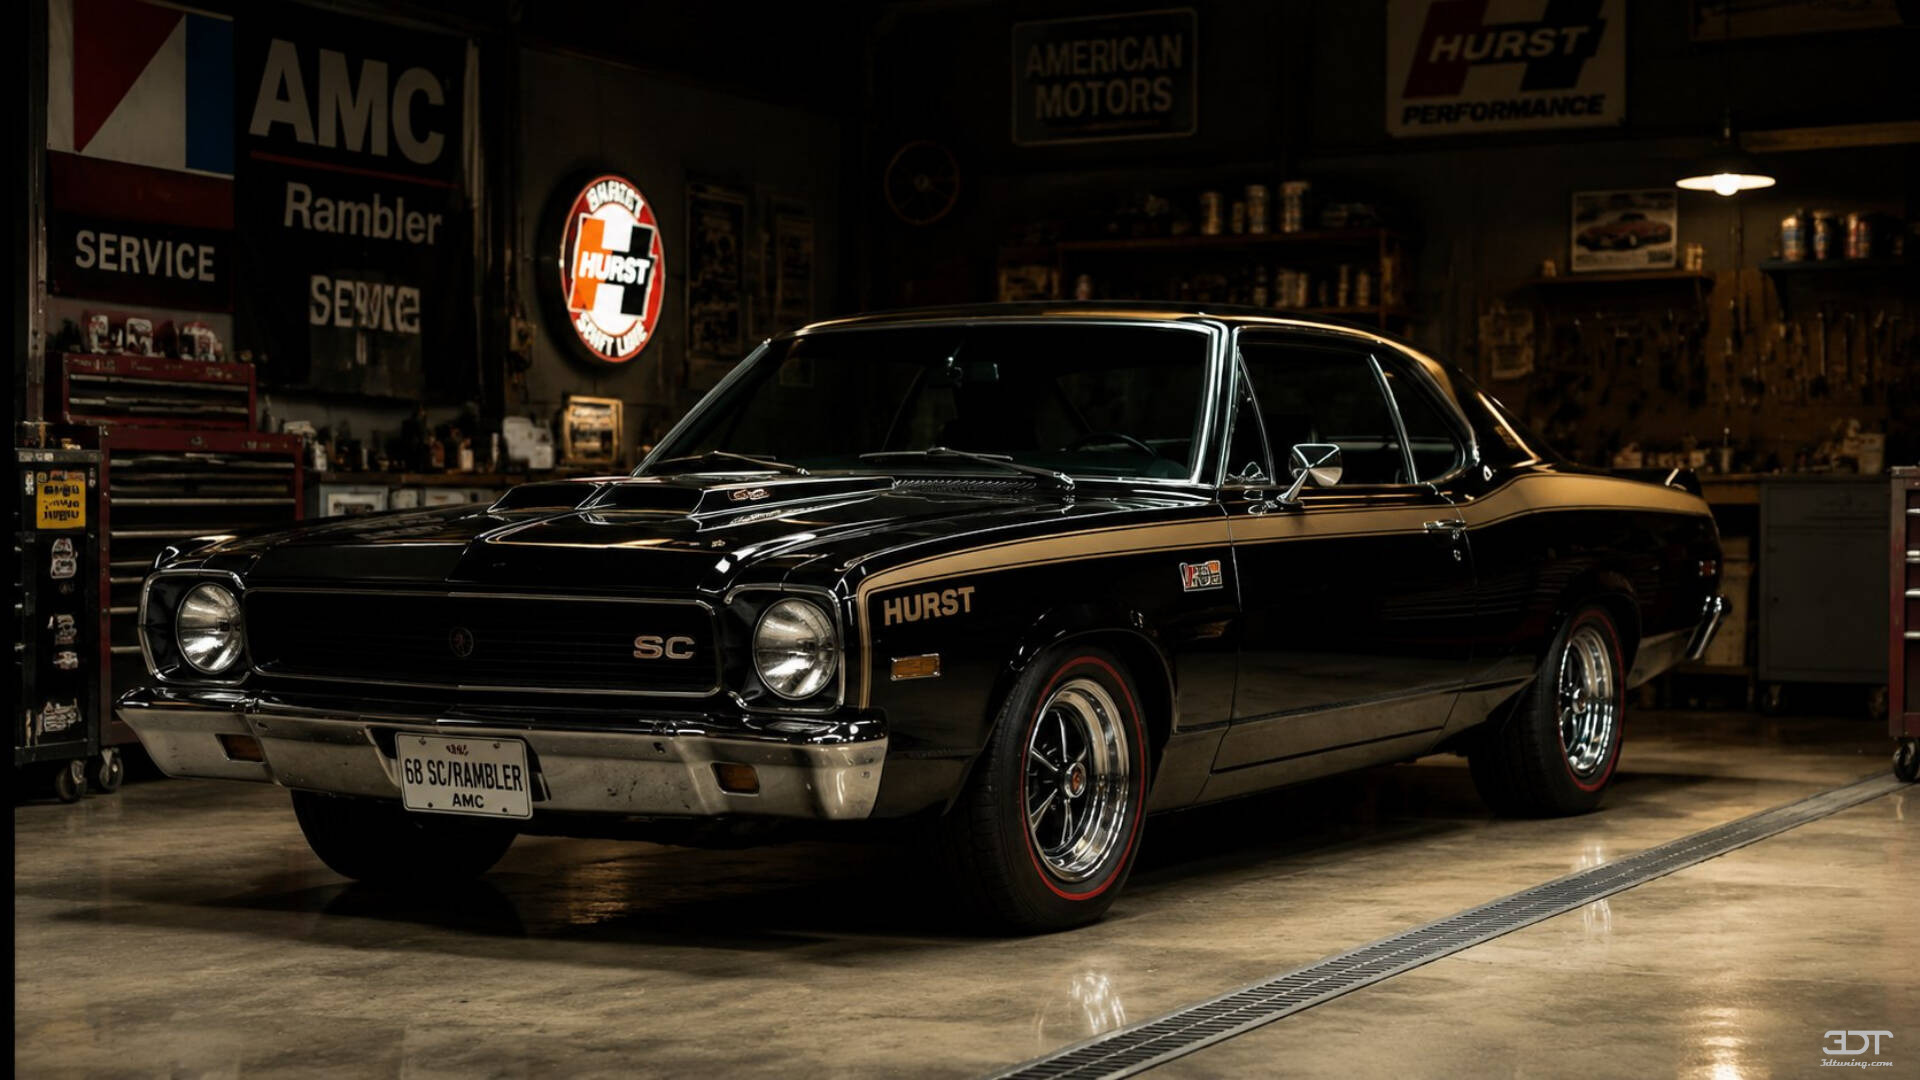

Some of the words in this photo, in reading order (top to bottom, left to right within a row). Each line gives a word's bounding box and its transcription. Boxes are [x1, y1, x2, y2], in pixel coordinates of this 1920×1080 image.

[1024, 32, 1184, 79] AMERICAN
[1427, 25, 1592, 63] HURST
[248, 37, 446, 166] AMC
[1034, 75, 1175, 121] MOTORS
[1403, 94, 1606, 125] PERFORMANCE
[282, 180, 444, 247] Rambler
[74, 229, 216, 283] SERVICE
[578, 250, 651, 286] HURST
[883, 585, 976, 626] HURST
[633, 635, 696, 660] SC
[404, 758, 424, 785] 68
[427, 759, 523, 792] SC/RAMBLER
[452, 793, 485, 809] AMC
